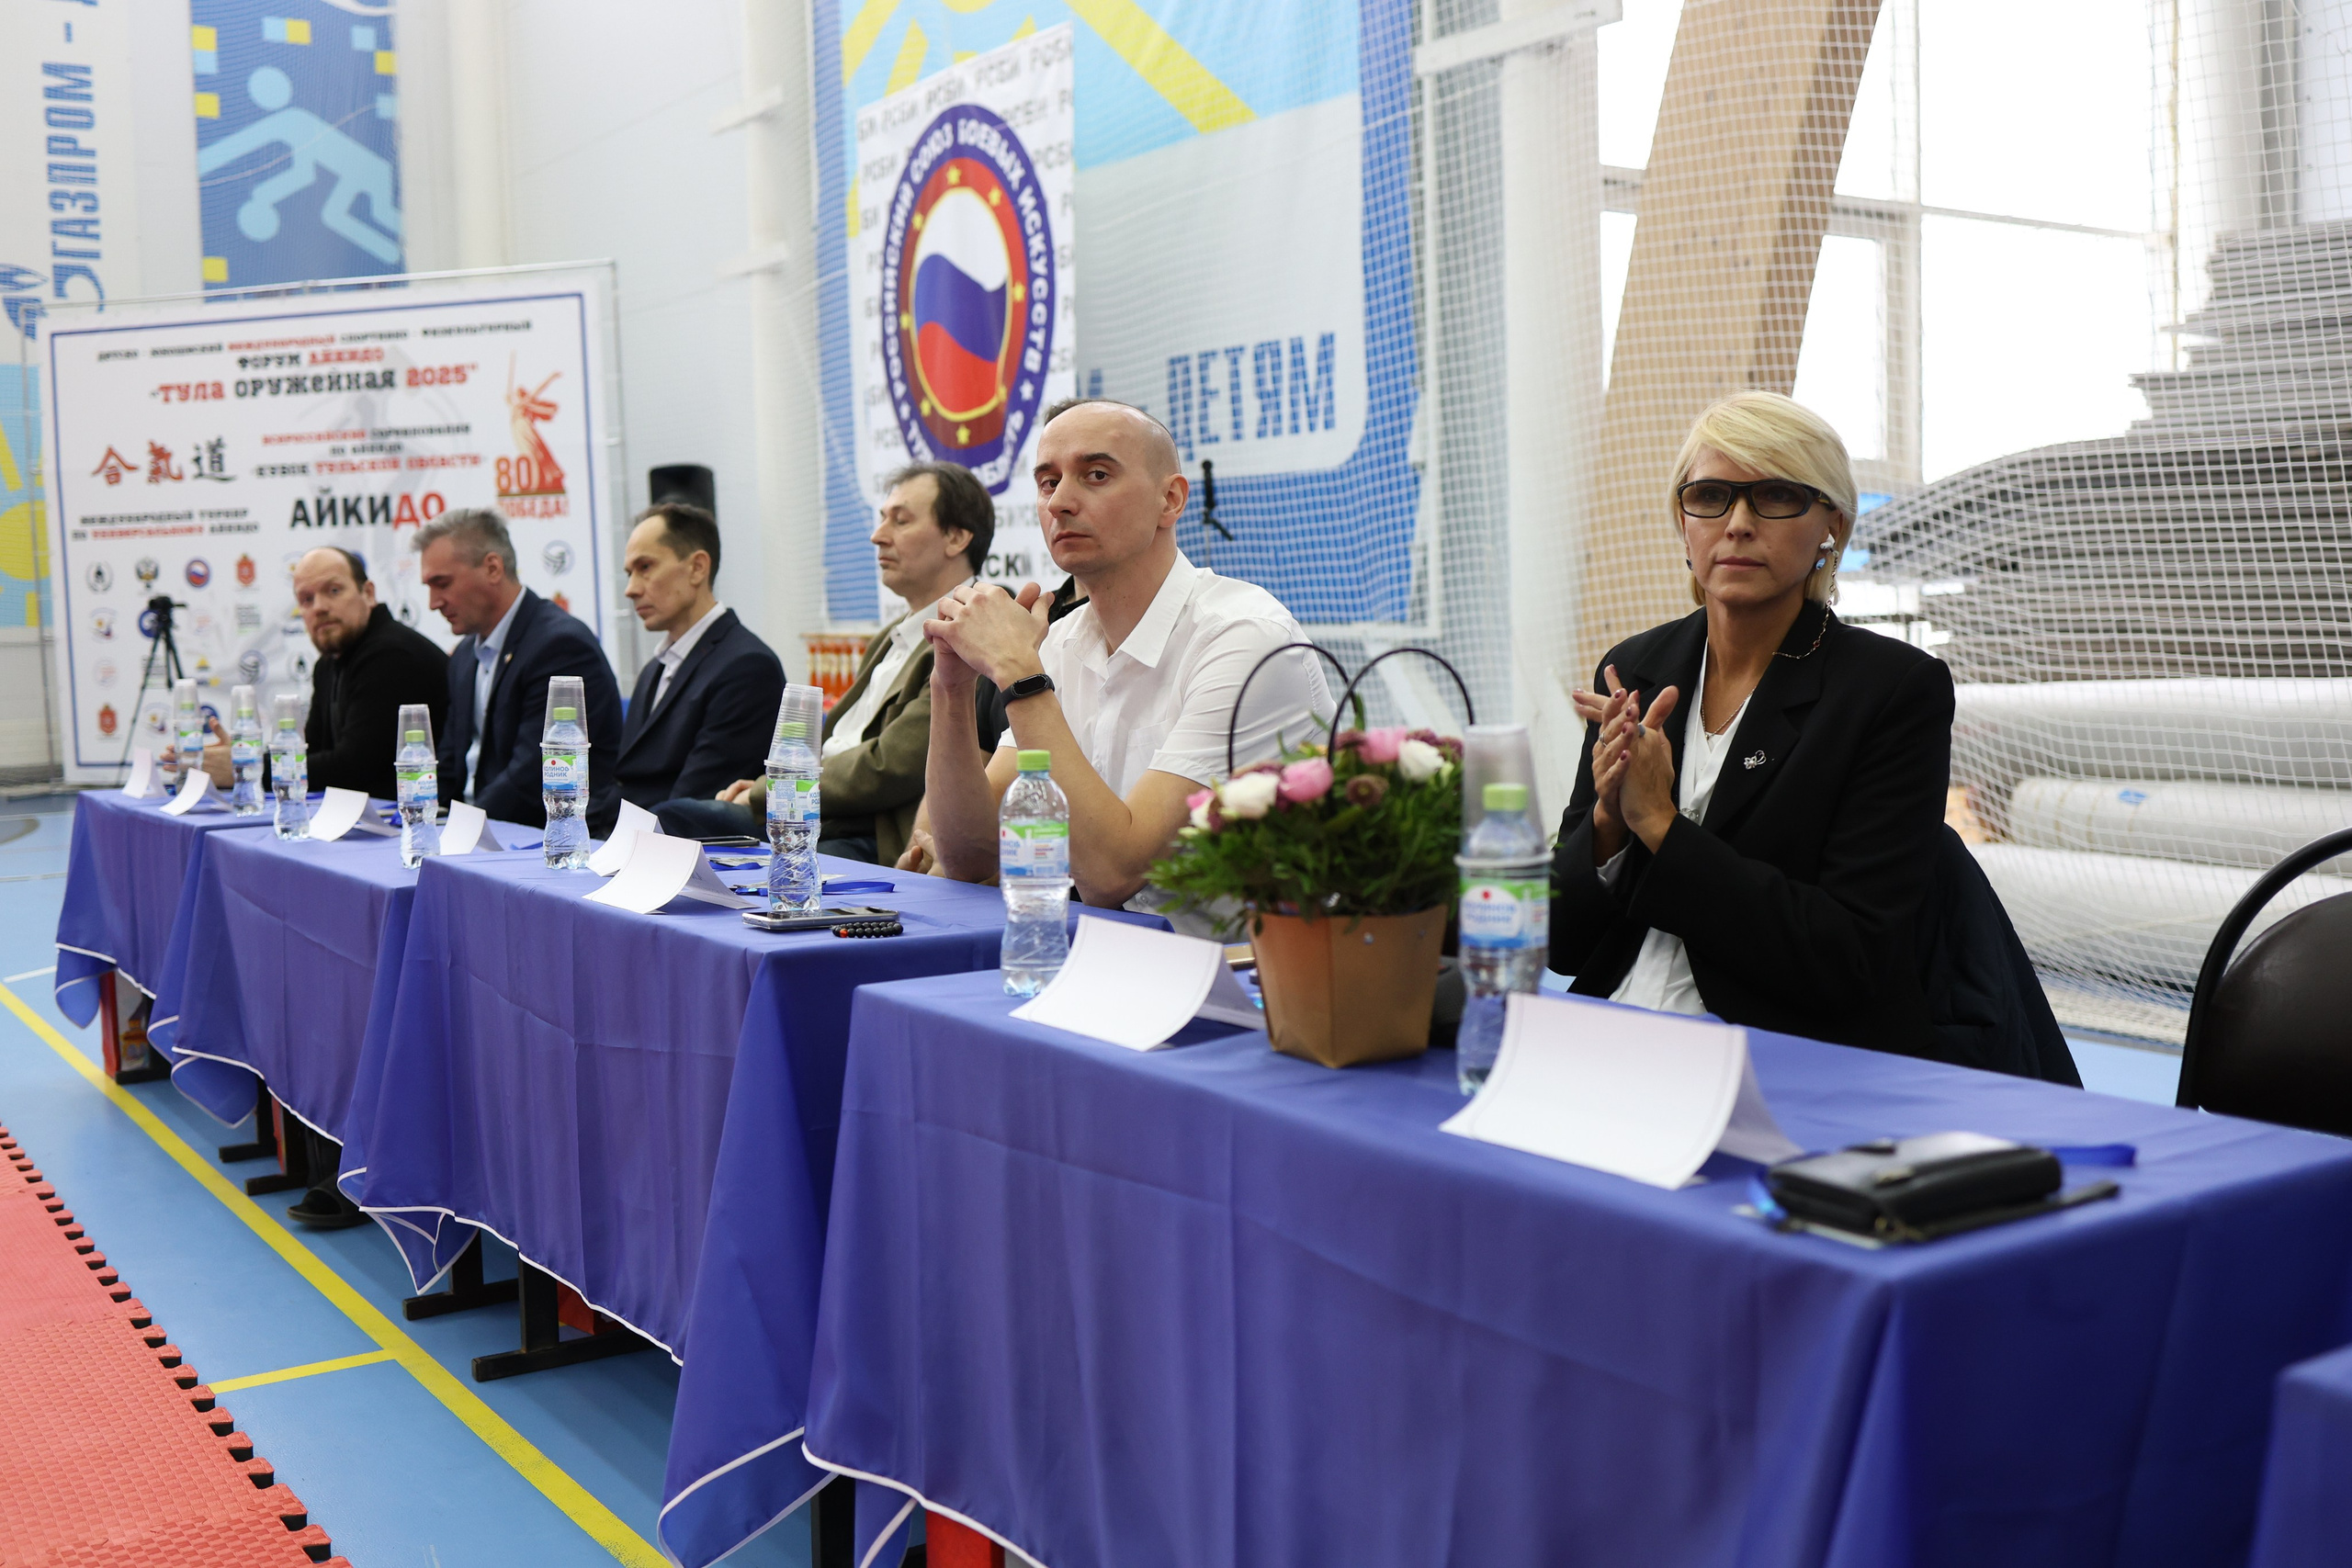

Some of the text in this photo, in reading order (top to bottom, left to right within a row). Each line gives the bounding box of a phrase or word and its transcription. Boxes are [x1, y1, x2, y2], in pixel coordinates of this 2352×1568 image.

[42, 61, 102, 259] ГАЗПРОМ
[910, 121, 954, 184] СОЮЗ
[957, 118, 1026, 191] БОЕВЫХ
[1017, 186, 1049, 374] ИСКУССТВ
[1167, 331, 1337, 461] ДЕТЯМ
[289, 487, 447, 530] АЙКИДО
[495, 456, 532, 493] 80
